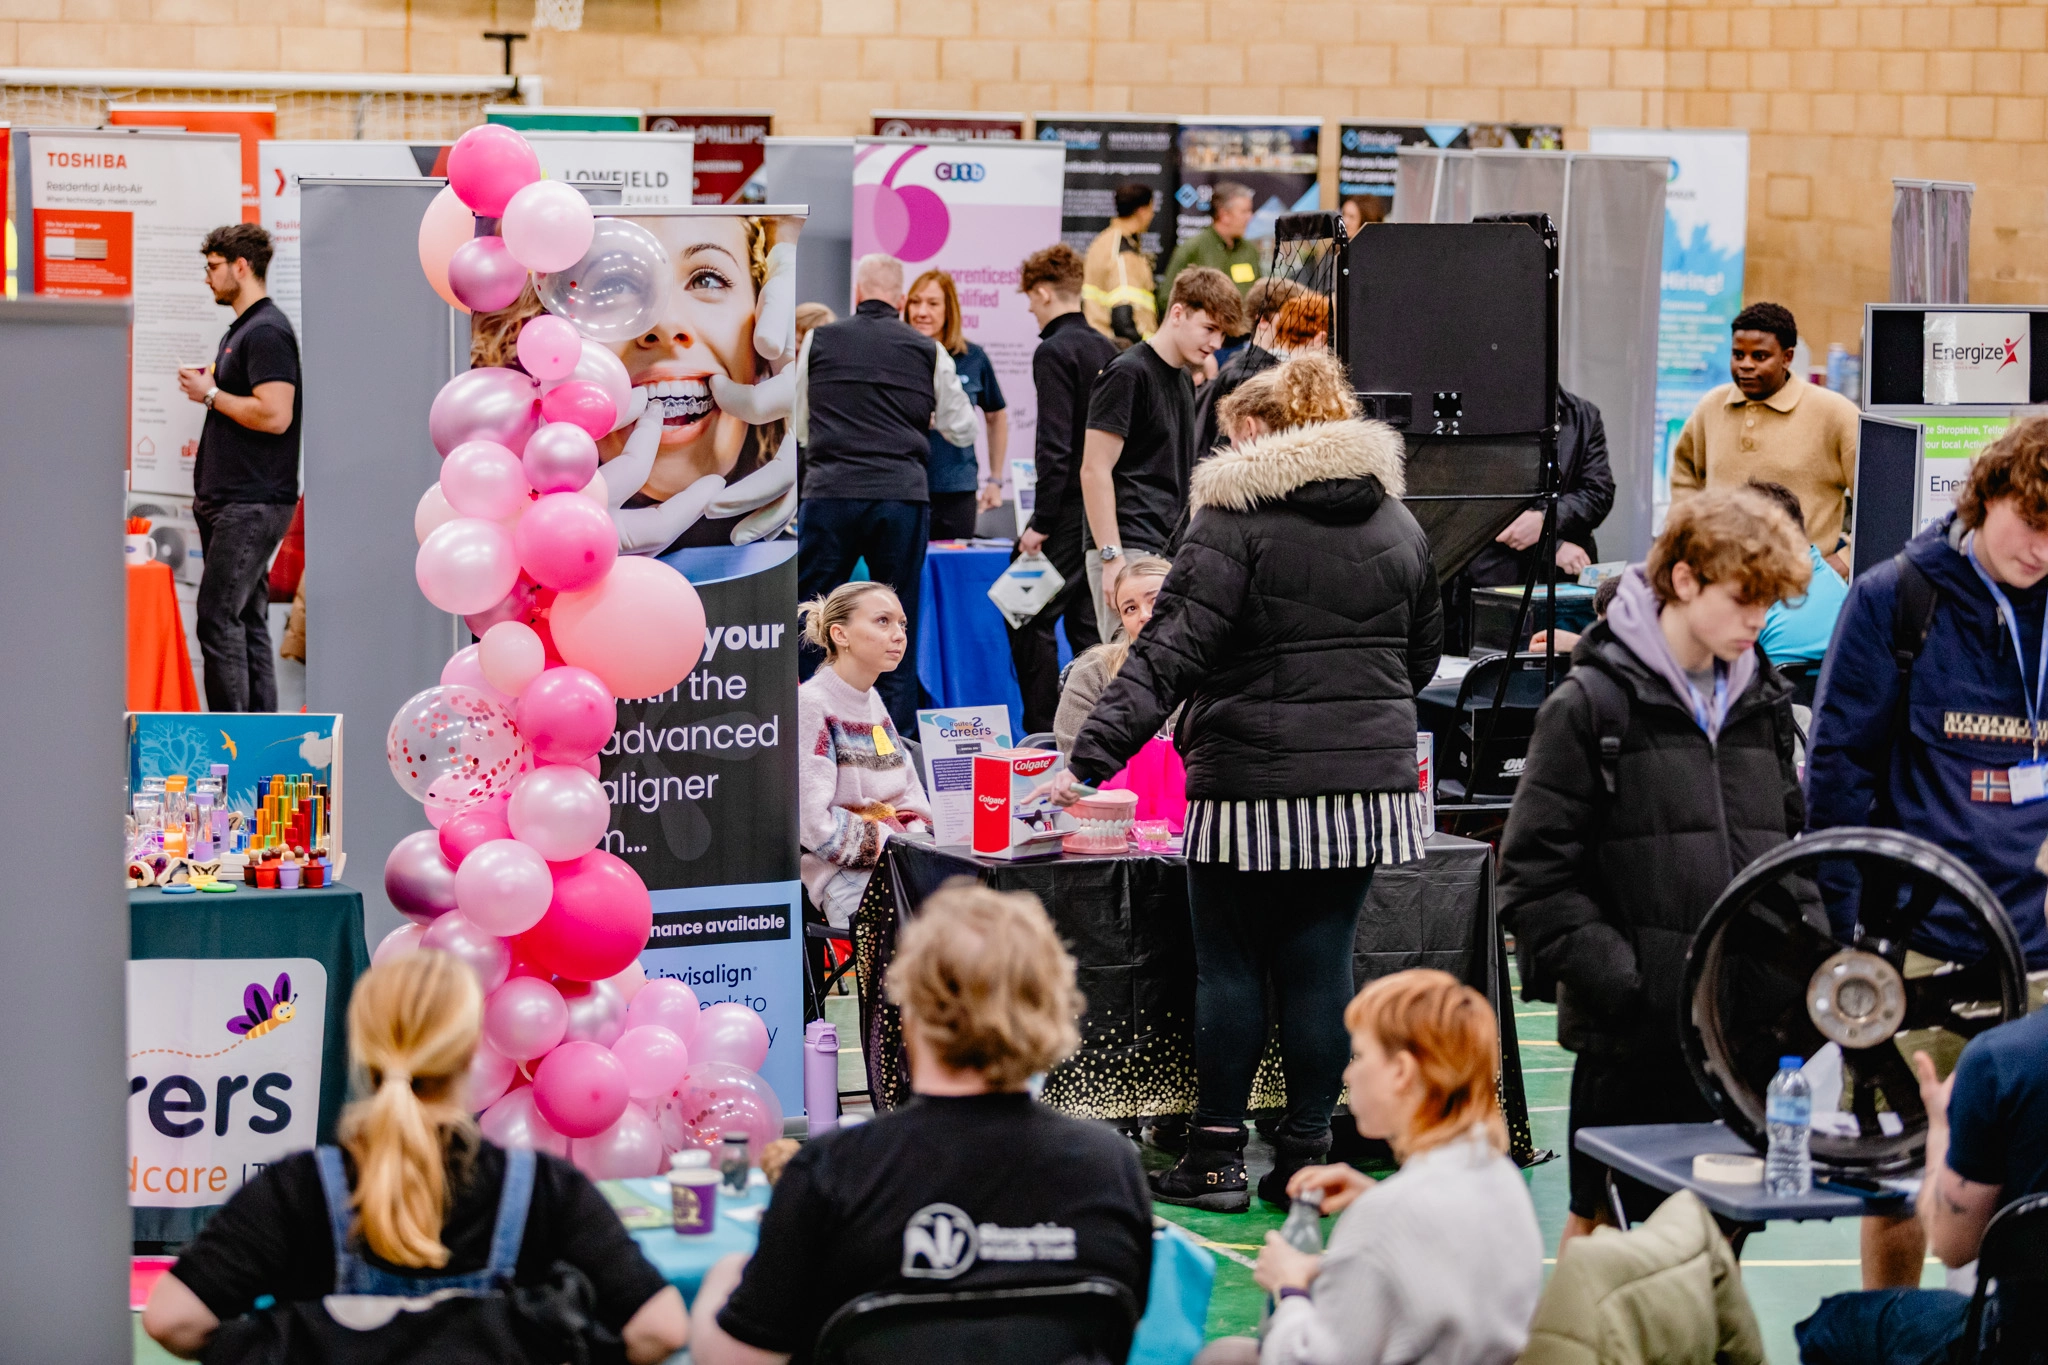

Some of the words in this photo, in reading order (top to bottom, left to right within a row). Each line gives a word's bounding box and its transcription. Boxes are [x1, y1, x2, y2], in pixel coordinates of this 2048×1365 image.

[47, 152, 128, 169] TOSHIBA
[46, 181, 100, 193] Residential
[628, 195, 669, 205] RAMES
[1932, 342, 2004, 364] Energize
[1936, 425, 1980, 436] Shropshire,
[1941, 439, 1960, 449] local
[1930, 476, 1967, 492] Ener
[703, 623, 785, 662] your
[689, 669, 747, 701] the
[972, 716, 983, 728] 2
[601, 714, 779, 756] advanced
[940, 726, 992, 738] Careers
[1014, 759, 1050, 772] Colgate
[600, 772, 719, 813] aligner
[978, 794, 1005, 805] Colgate
[650, 921, 703, 938] nance
[705, 913, 785, 936] available
